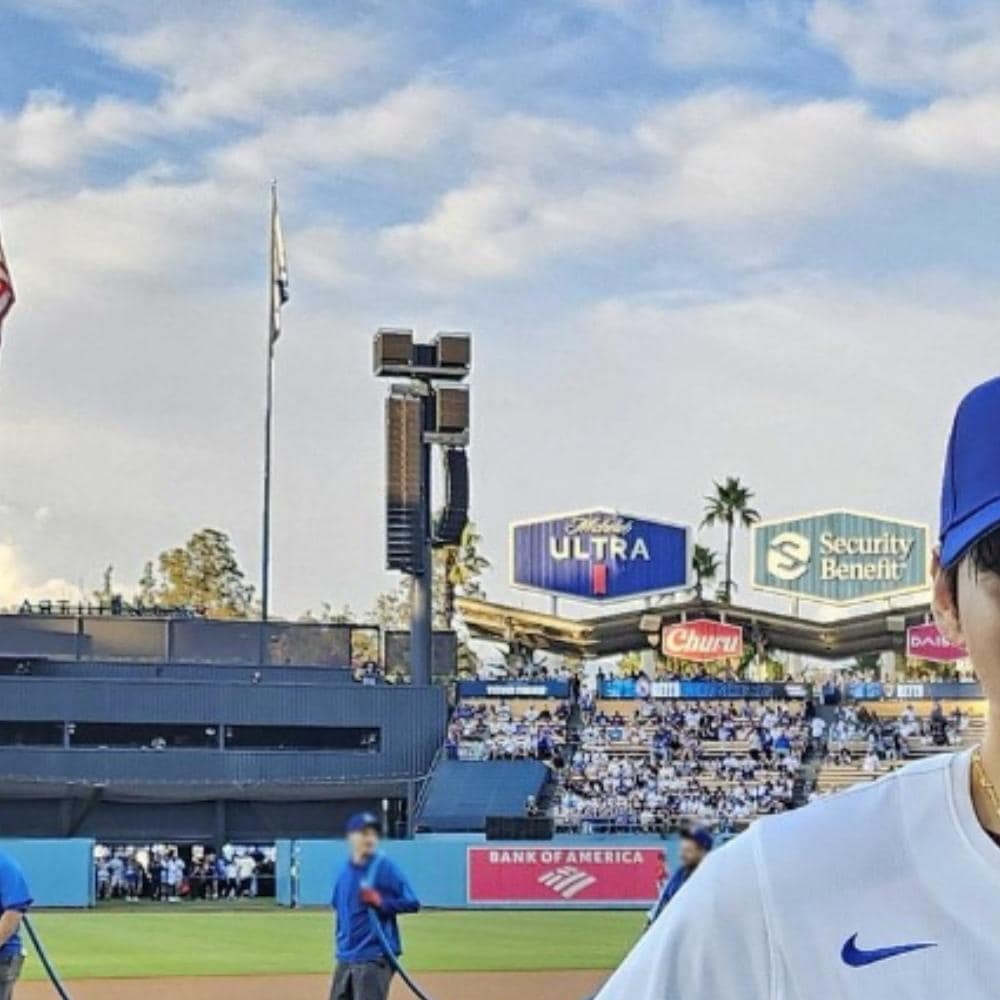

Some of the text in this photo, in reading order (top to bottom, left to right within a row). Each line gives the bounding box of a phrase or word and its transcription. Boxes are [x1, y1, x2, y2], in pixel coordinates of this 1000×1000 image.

[550, 535, 650, 560] ULTRA
[819, 531, 914, 559] Security
[820, 557, 903, 580] Benefit
[666, 628, 738, 653] Churu
[489, 851, 644, 864] BANK OF AMERICA
